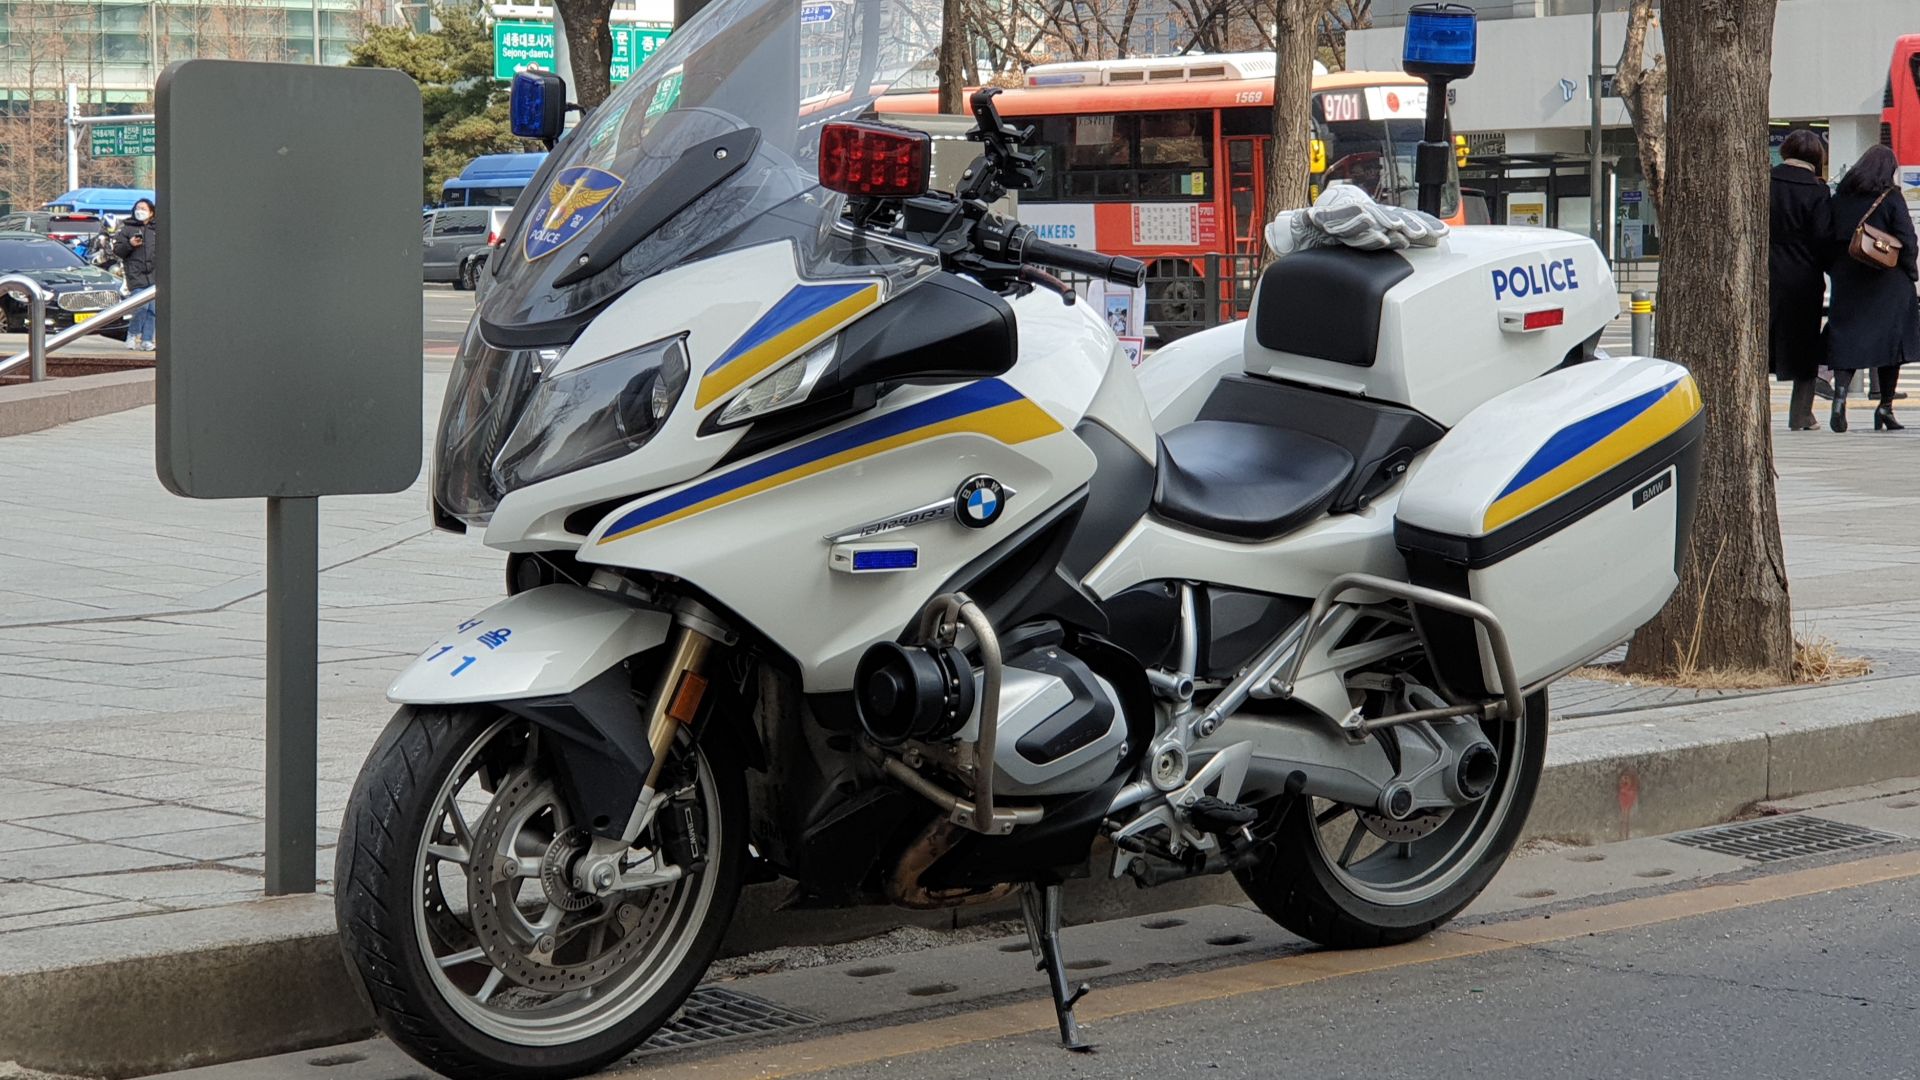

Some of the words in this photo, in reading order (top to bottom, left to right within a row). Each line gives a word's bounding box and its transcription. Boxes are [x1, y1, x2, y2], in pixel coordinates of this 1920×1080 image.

[502, 48, 549, 59] Sejong-daero
[1234, 91, 1263, 104] 1569
[1324, 94, 1359, 122] 9701
[530, 230, 560, 244] POLICE
[1491, 258, 1579, 301] POLICE
[962, 478, 1000, 499] BMW
[1642, 480, 1664, 502] BMW
[687, 823, 698, 845] BMW
